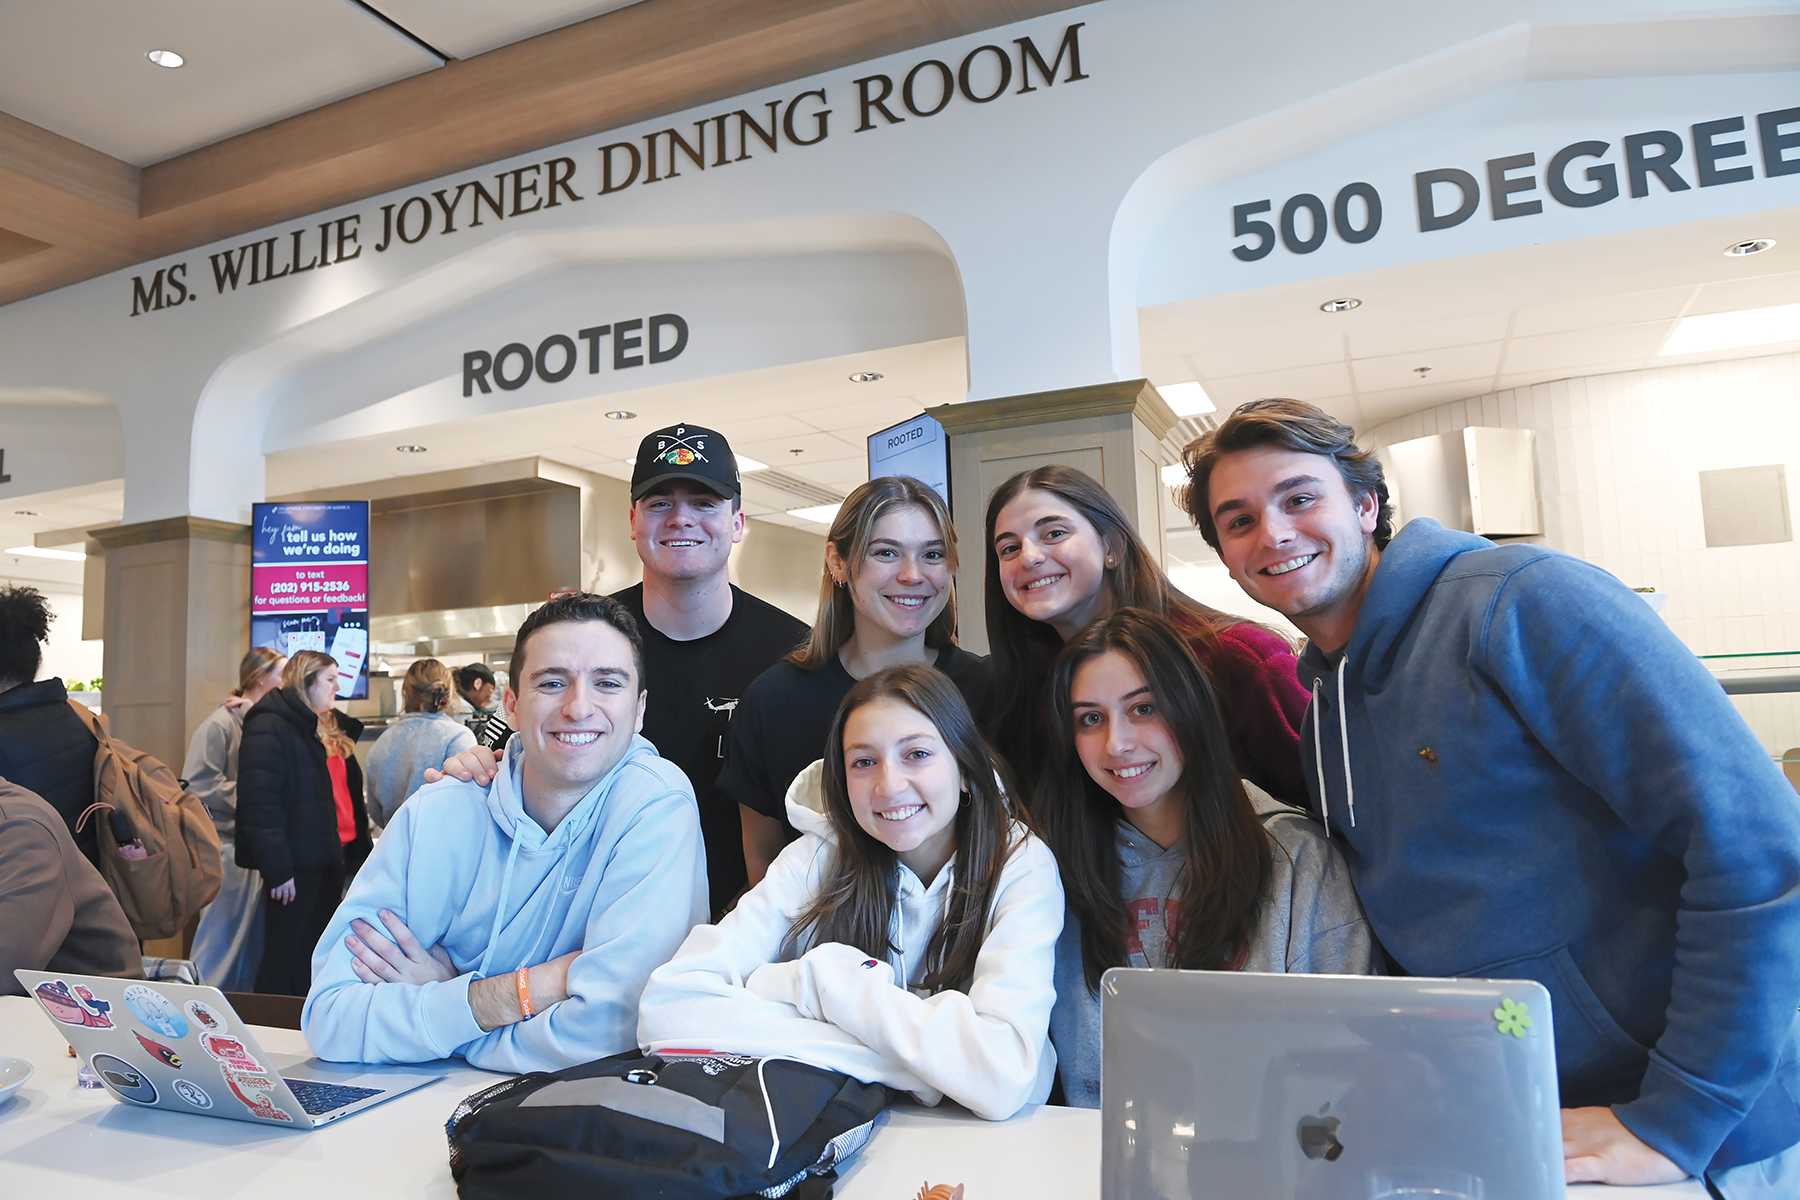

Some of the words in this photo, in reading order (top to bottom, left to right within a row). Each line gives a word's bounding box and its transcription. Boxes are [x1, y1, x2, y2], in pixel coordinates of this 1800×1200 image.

[129, 263, 197, 317] MS.
[209, 214, 362, 295] WILLIE
[375, 157, 583, 252] JOYNER
[597, 87, 832, 196] DINING
[853, 22, 1090, 133] ROOM
[1232, 182, 1382, 262] 500
[463, 313, 690, 397] ROOTED
[887, 427, 924, 449] ROOTED
[261, 515, 279, 545] hey
[286, 529, 308, 543] tell
[311, 532, 326, 542] us
[329, 529, 357, 541] how
[283, 543, 320, 556] we're
[323, 542, 360, 557] doing
[295, 571, 306, 579] to
[307, 571, 325, 579] text
[270, 582, 299, 594] (202)
[300, 581, 350, 592] 915-2536
[254, 595, 267, 605] for
[269, 595, 311, 606] questions
[323, 592, 366, 603] feedback!
